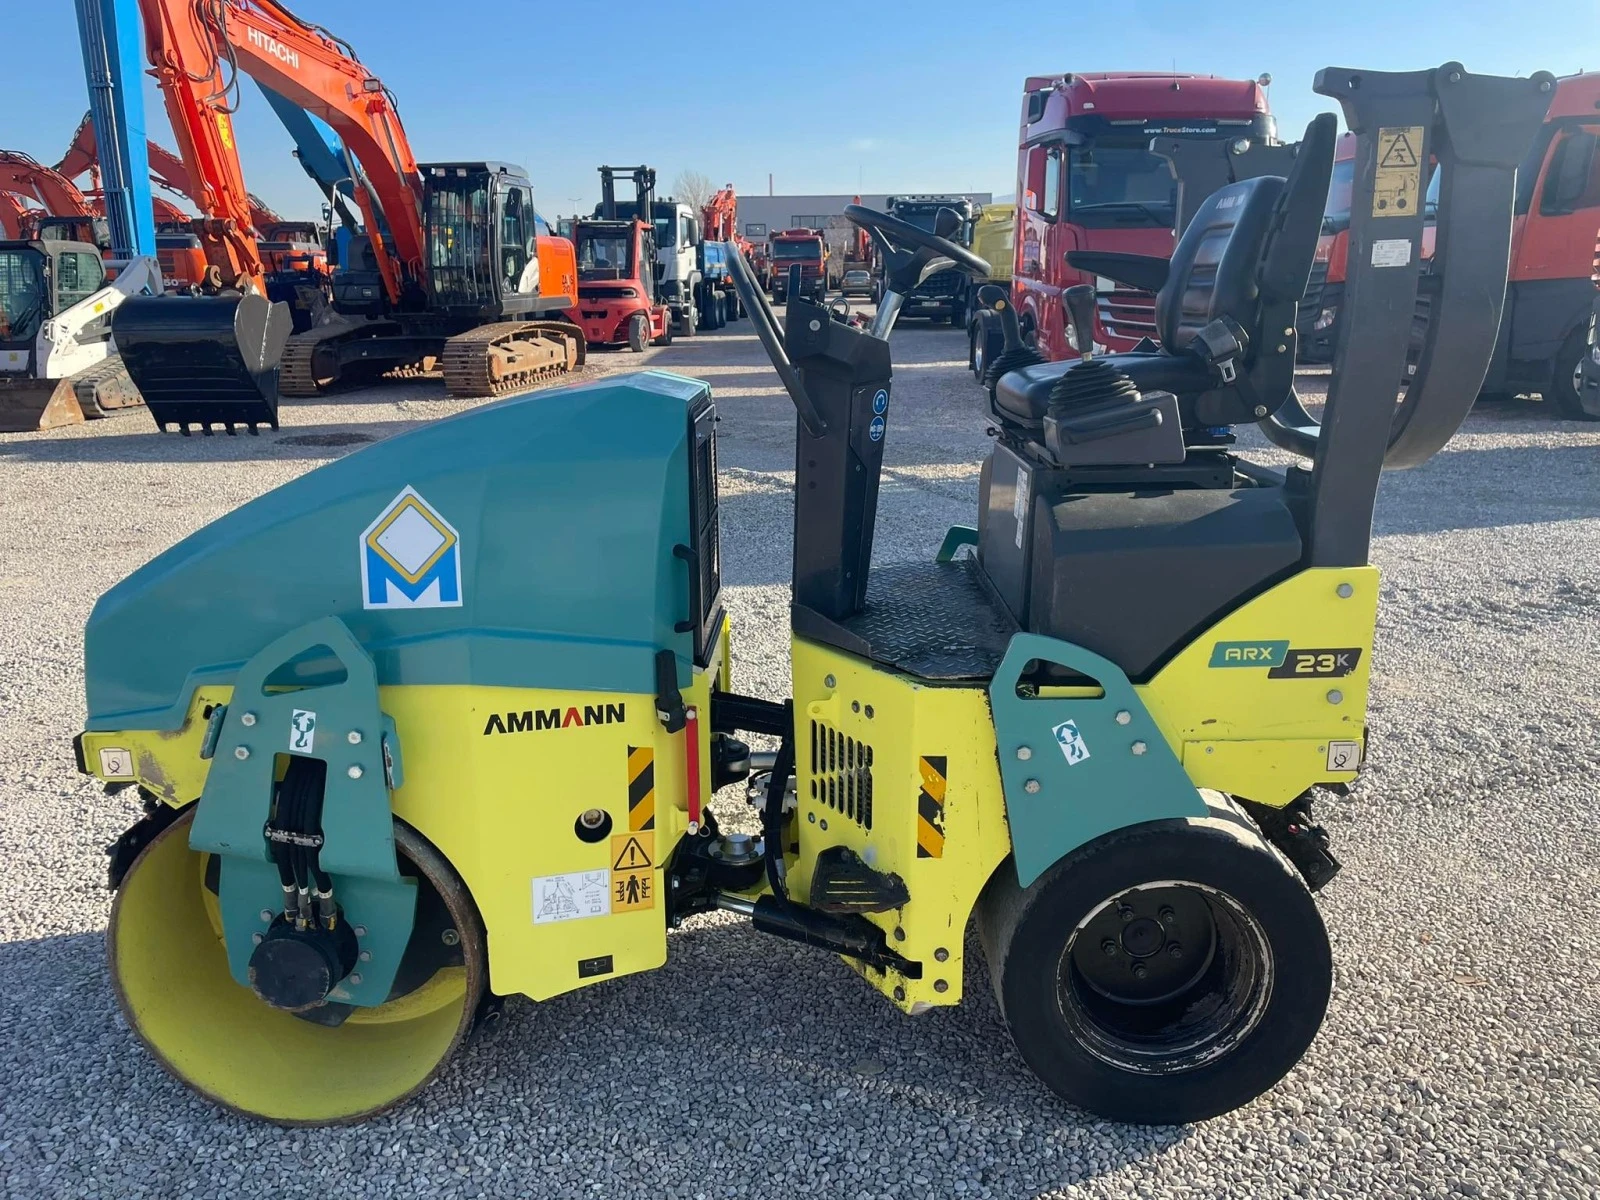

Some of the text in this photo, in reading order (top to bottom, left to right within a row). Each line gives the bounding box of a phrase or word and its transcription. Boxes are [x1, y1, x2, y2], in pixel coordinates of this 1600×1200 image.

[247, 25, 299, 69] HITACHI
[1225, 647, 1273, 661] ARX
[483, 703, 625, 736] AMMANN
